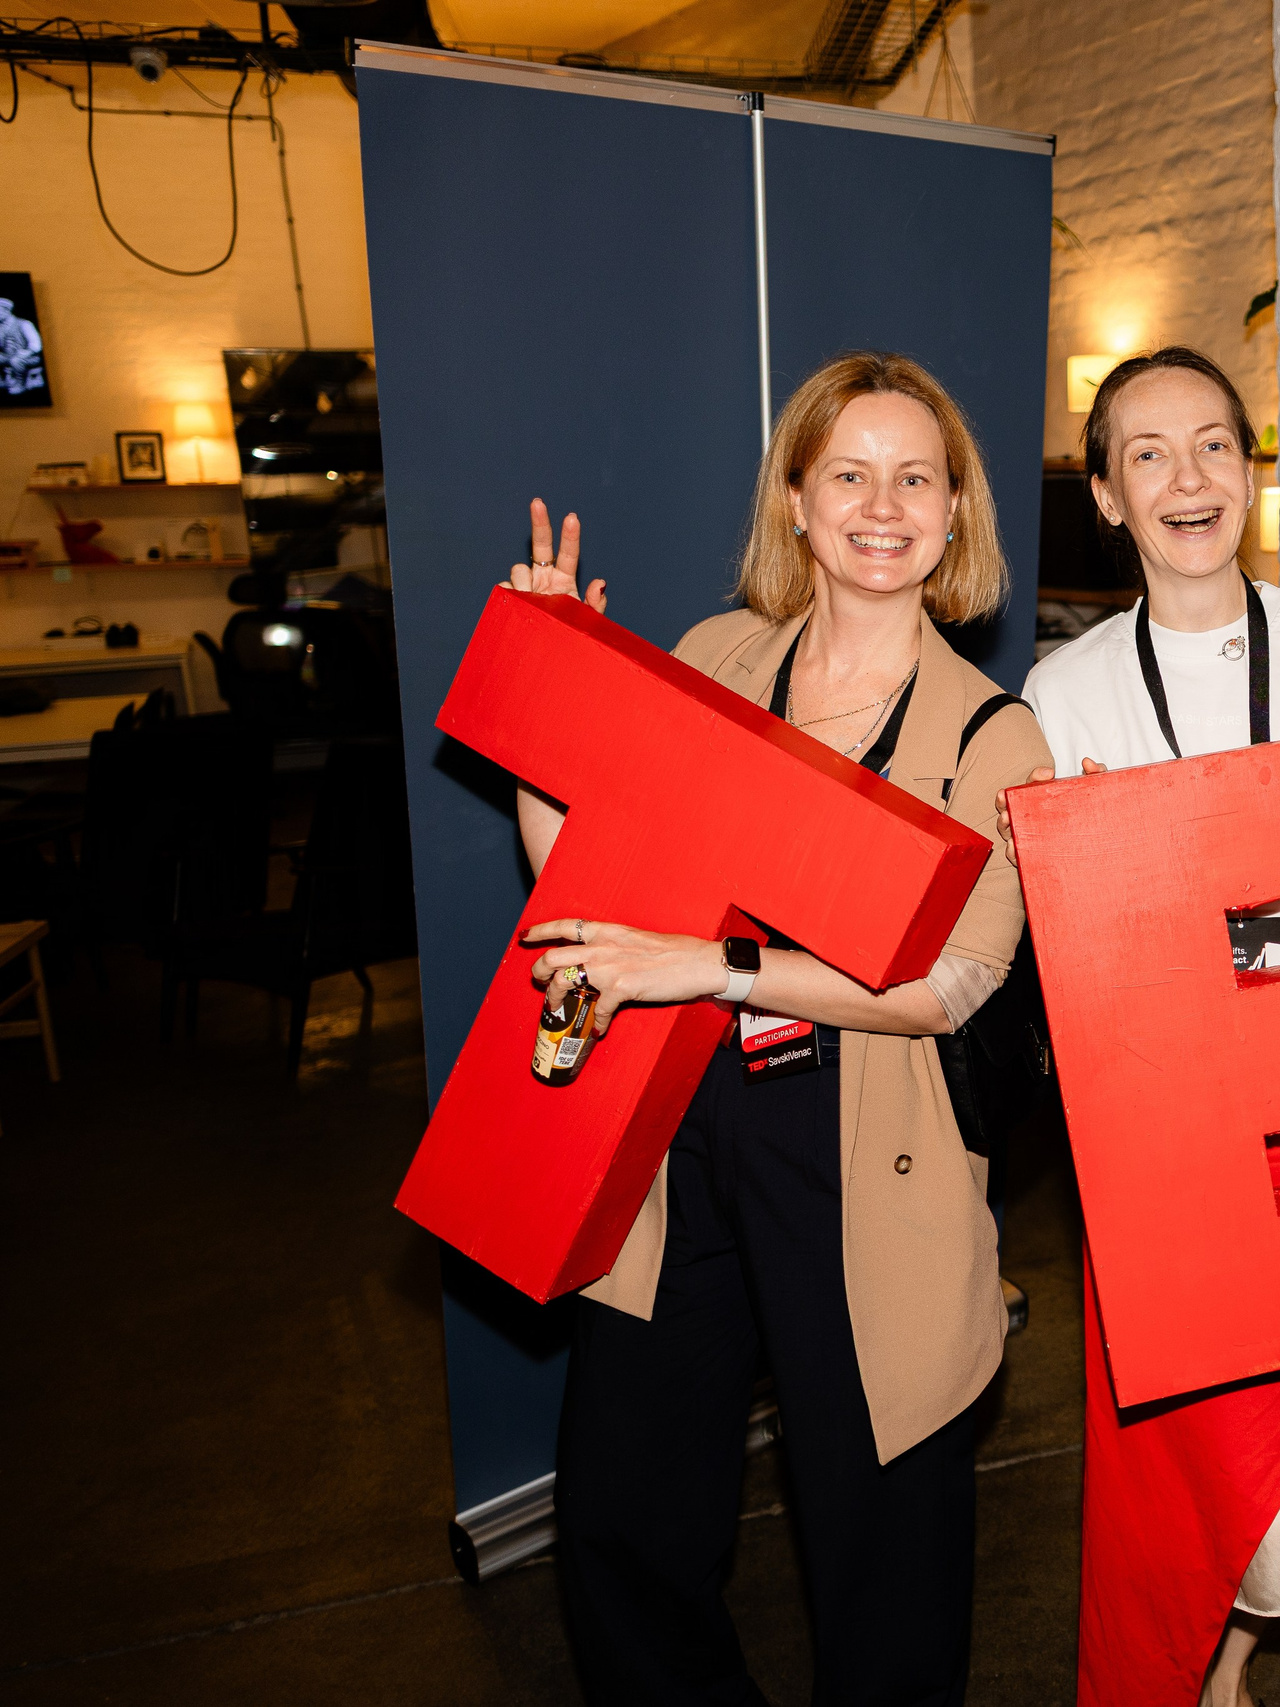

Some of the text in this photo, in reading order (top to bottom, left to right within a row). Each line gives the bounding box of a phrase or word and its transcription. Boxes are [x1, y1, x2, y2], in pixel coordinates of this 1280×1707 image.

[395, 584, 993, 1305] T
[1232, 947, 1247, 955] ifts.
[754, 1025, 799, 1047] PARTICIPANT
